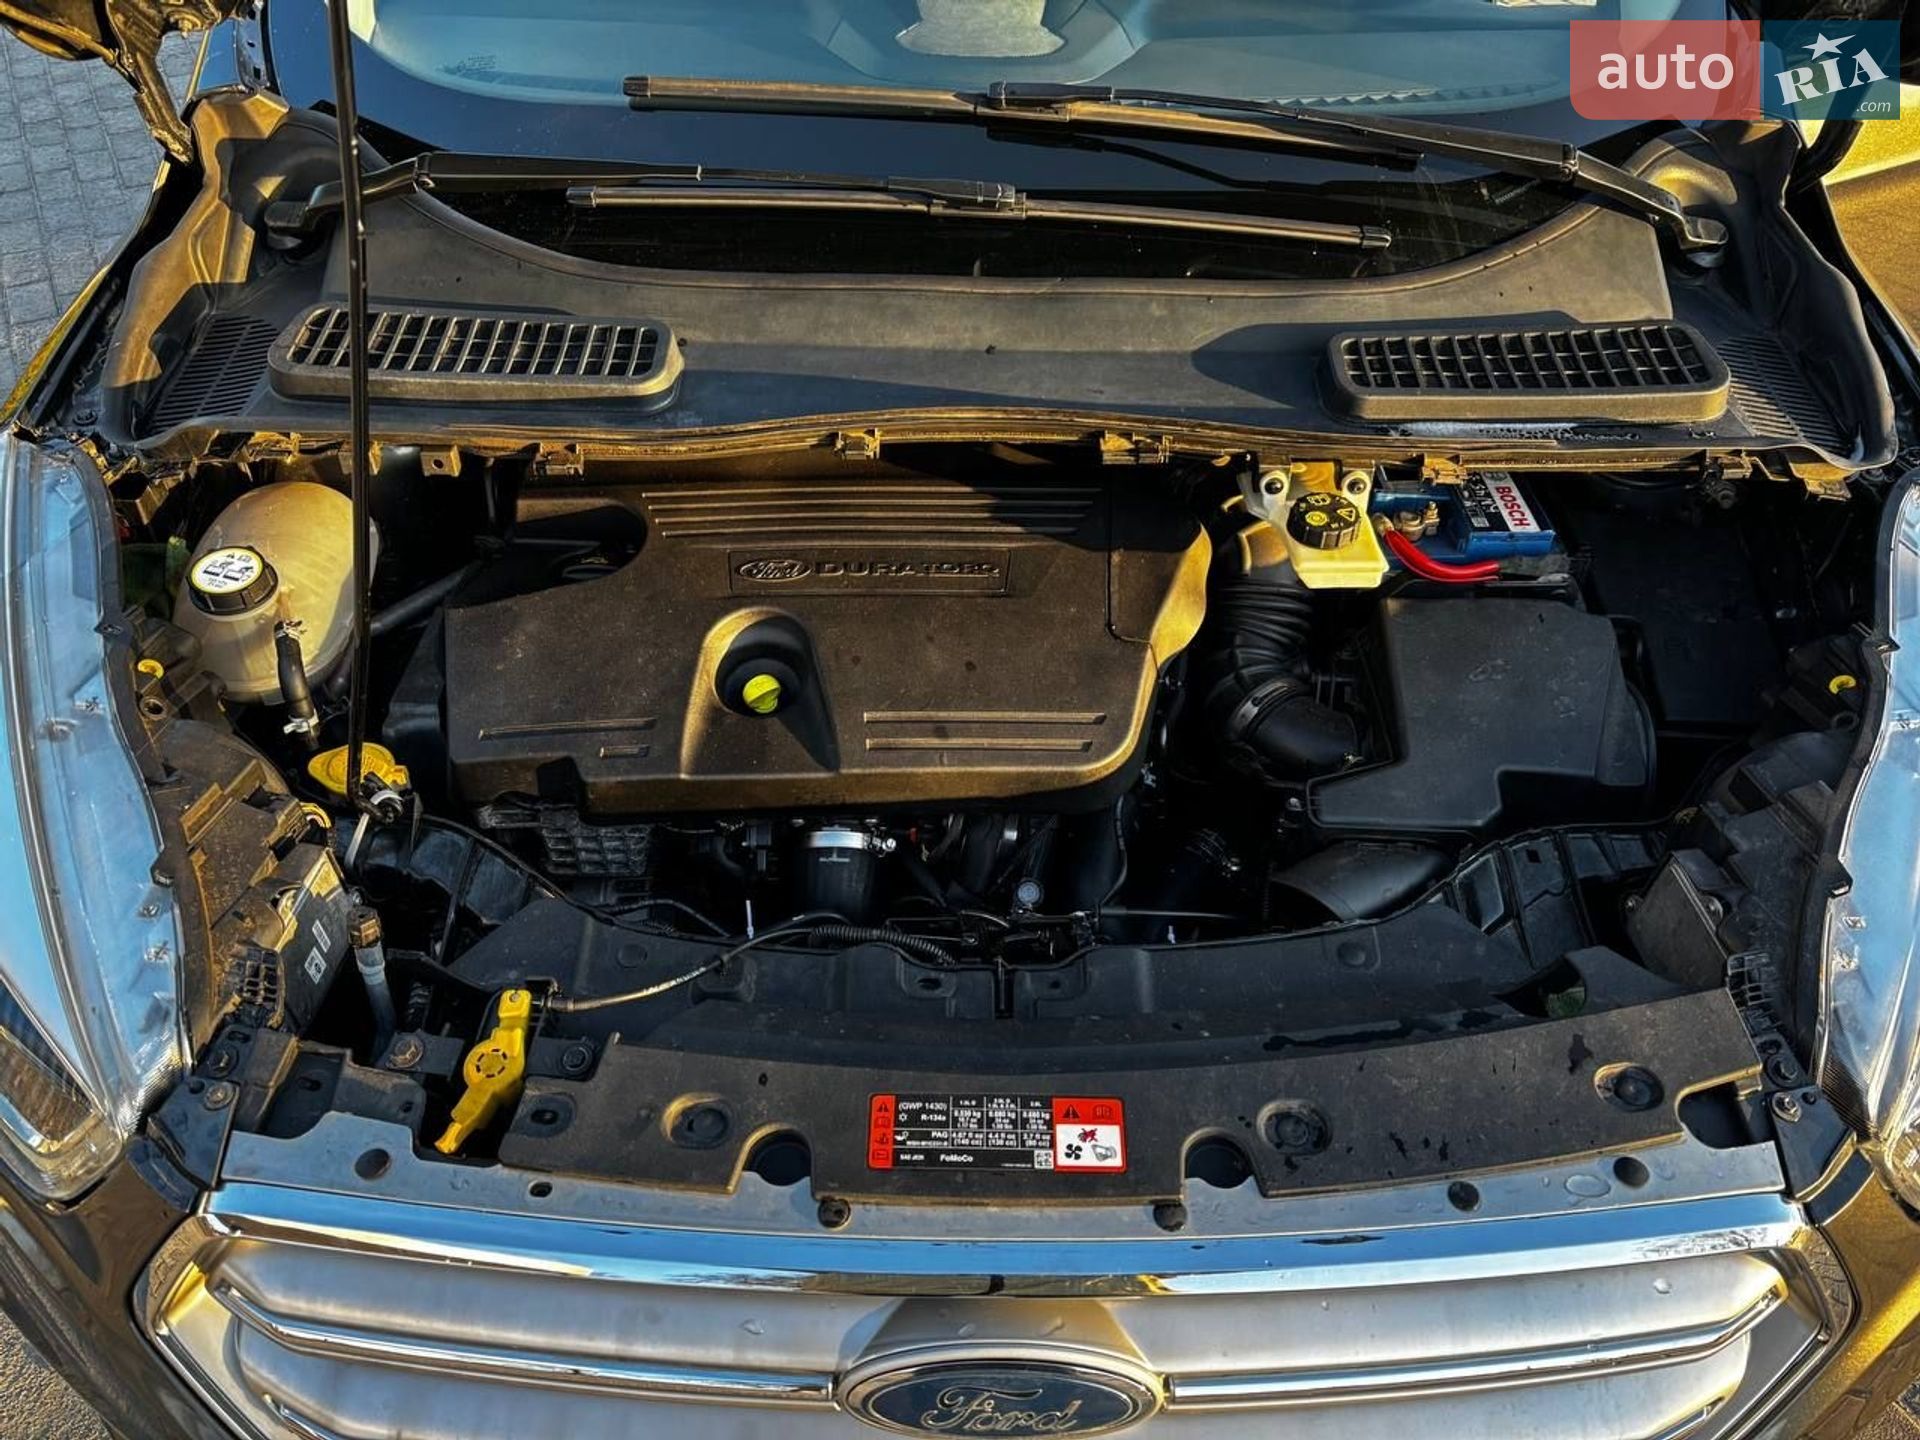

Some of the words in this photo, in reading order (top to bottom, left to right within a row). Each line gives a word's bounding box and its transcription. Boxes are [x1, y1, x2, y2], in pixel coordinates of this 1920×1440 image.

[1494, 485, 1531, 527] BOSCH
[899, 1102, 923, 1111] (GWP
[921, 1113, 946, 1121] R-134a
[932, 1131, 948, 1139] PAG
[920, 1386, 1082, 1431] Ford
